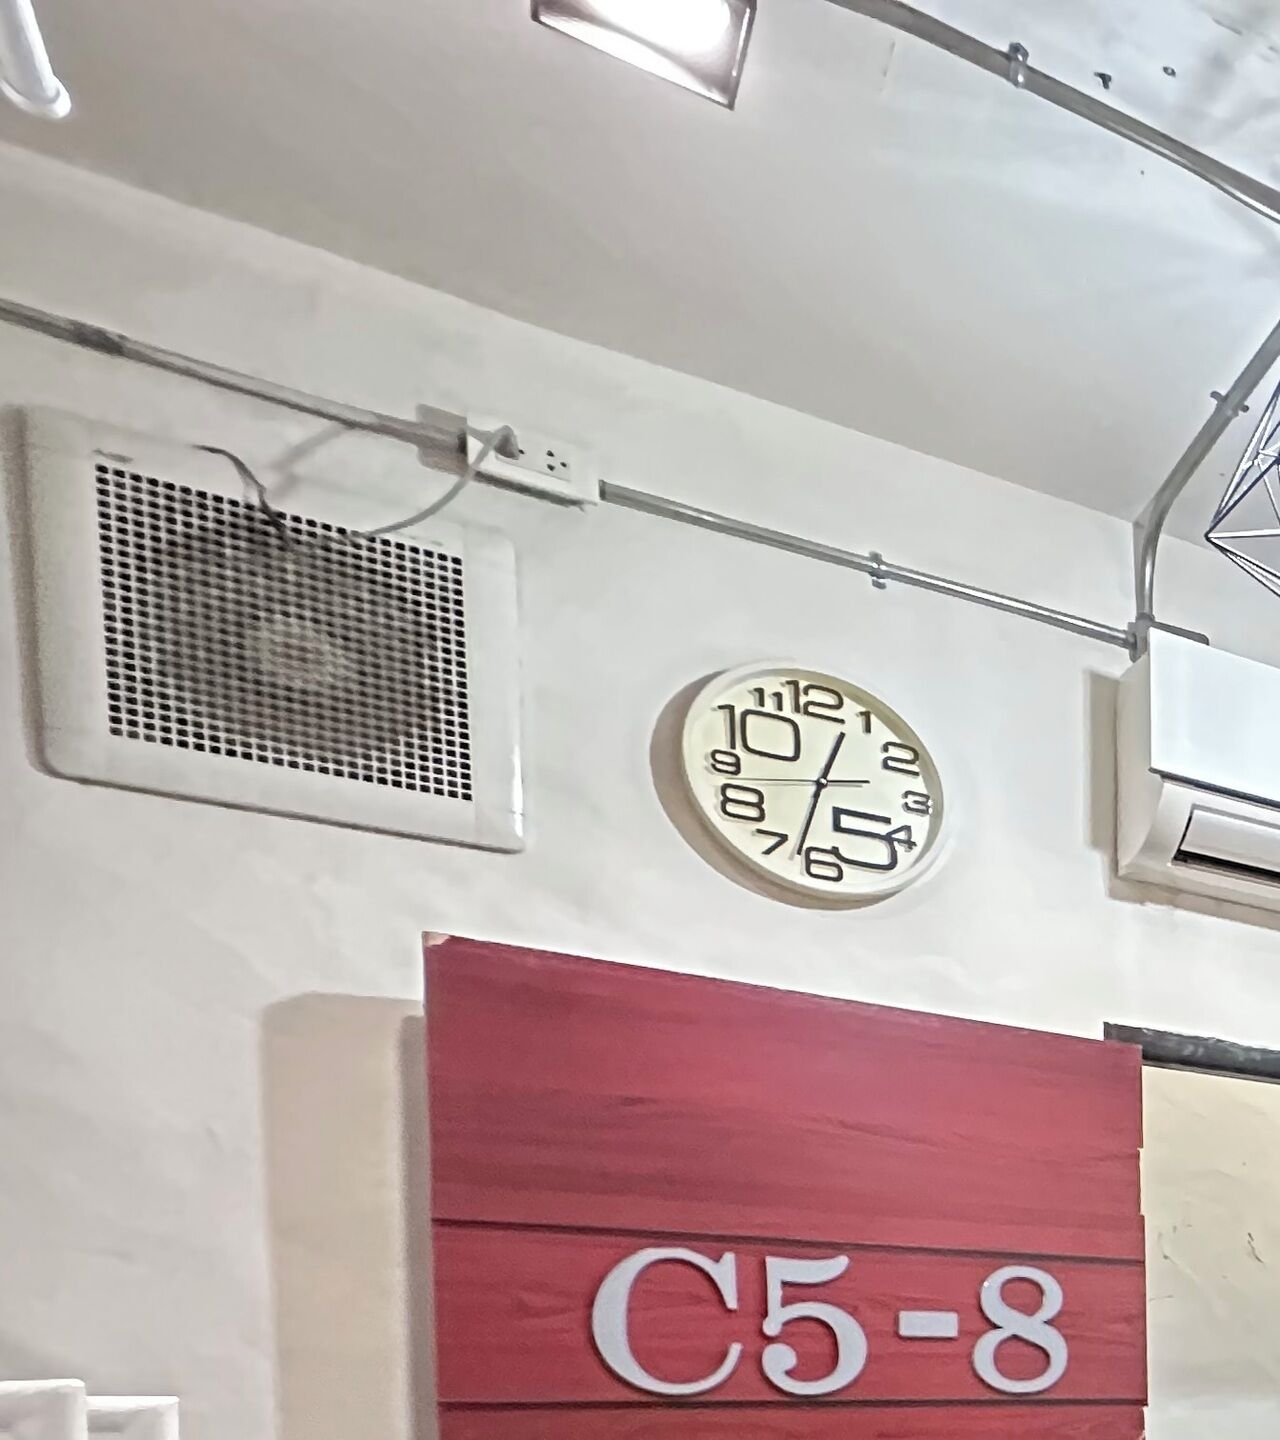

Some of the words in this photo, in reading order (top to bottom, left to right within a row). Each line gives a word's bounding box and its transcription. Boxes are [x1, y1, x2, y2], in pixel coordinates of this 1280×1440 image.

[752, 687, 783, 712] 11
[783, 679, 846, 725] 12
[714, 704, 801, 762] 10
[857, 710, 871, 734] 1
[710, 749, 741, 775] 9
[881, 741, 919, 776] 2
[720, 782, 765, 822] 8
[903, 790, 931, 815] 3
[755, 829, 788, 855] 7
[832, 806, 897, 871] 5
[885, 825, 917, 852] 4
[803, 845, 844, 882] 6
[591, 1246, 1069, 1397] C5-8
